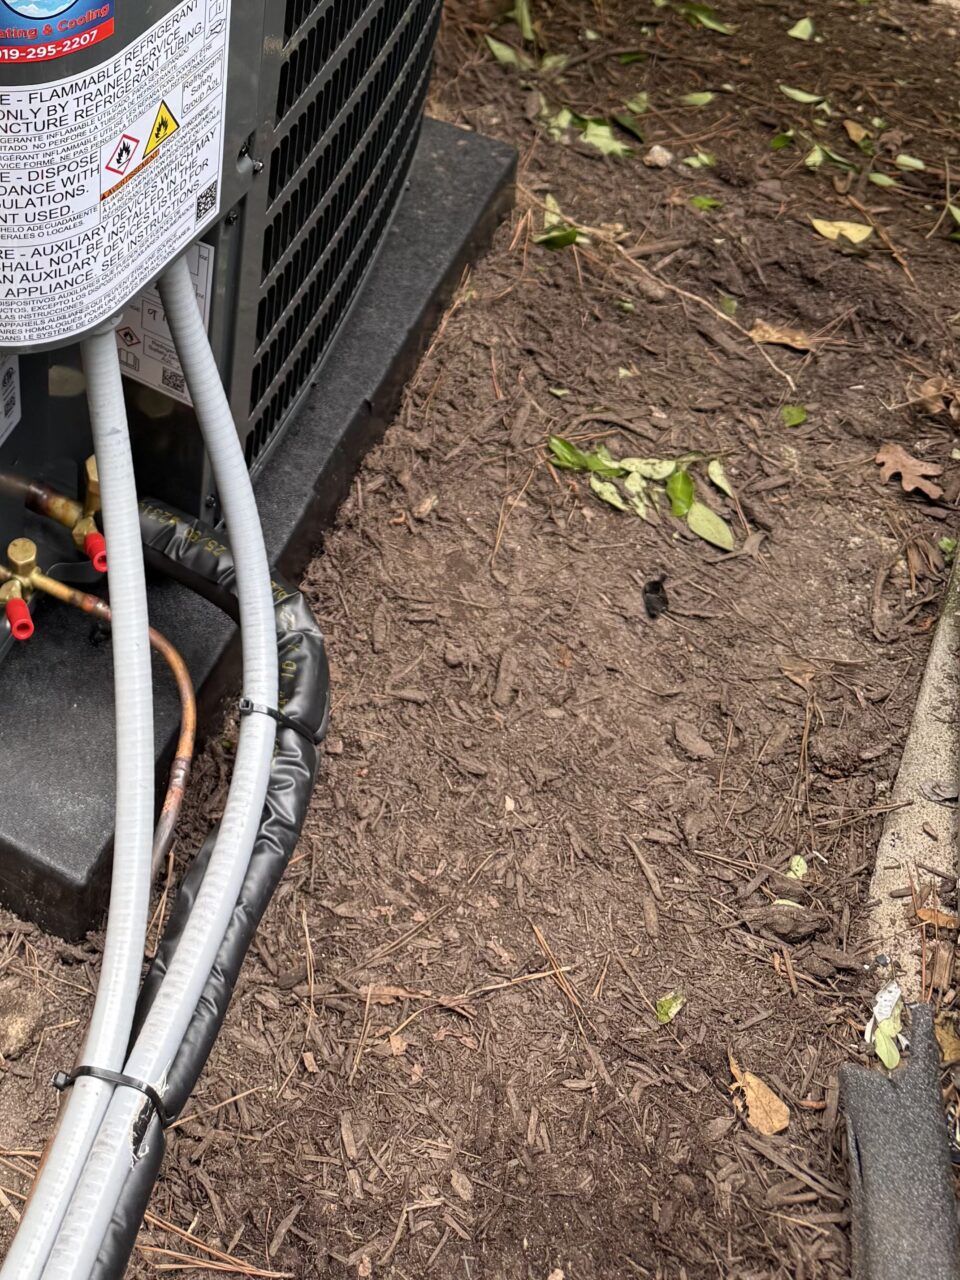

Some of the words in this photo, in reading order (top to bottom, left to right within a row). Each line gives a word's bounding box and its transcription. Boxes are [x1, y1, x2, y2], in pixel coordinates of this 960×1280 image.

[42, 24, 53, 35] &
[58, 4, 110, 32] Cooling
[28, 59, 121, 104] FLAMMABLE
[47, 101, 69, 117] BY
[73, 68, 132, 106] TRAINED
[135, 26, 181, 72] SERVICE
[183, 53, 223, 90] Refrigerant
[190, 72, 213, 97] Safety
[74, 58, 160, 122] REFRIGERANT
[183, 91, 204, 114] Group
[28, 152, 99, 182] DISPOSE
[61, 164, 100, 188] WITH
[31, 221, 110, 259] AUXILIARY
[112, 181, 158, 223] DEVICES
[161, 148, 195, 184] WHICH
[196, 127, 217, 151] MAY
[19, 250, 100, 284] AUXILIARY
[104, 212, 150, 255] DEVICES
[153, 179, 187, 211] LISTED
[189, 158, 209, 180] FOR
[25, 205, 74, 223] USED.
[50, 249, 81, 267] NOT
[87, 238, 104, 259] BE
[108, 190, 165, 242] INSTALLED
[166, 179, 177, 195] IN
[183, 158, 198, 182] THE
[101, 248, 126, 271] SEE
